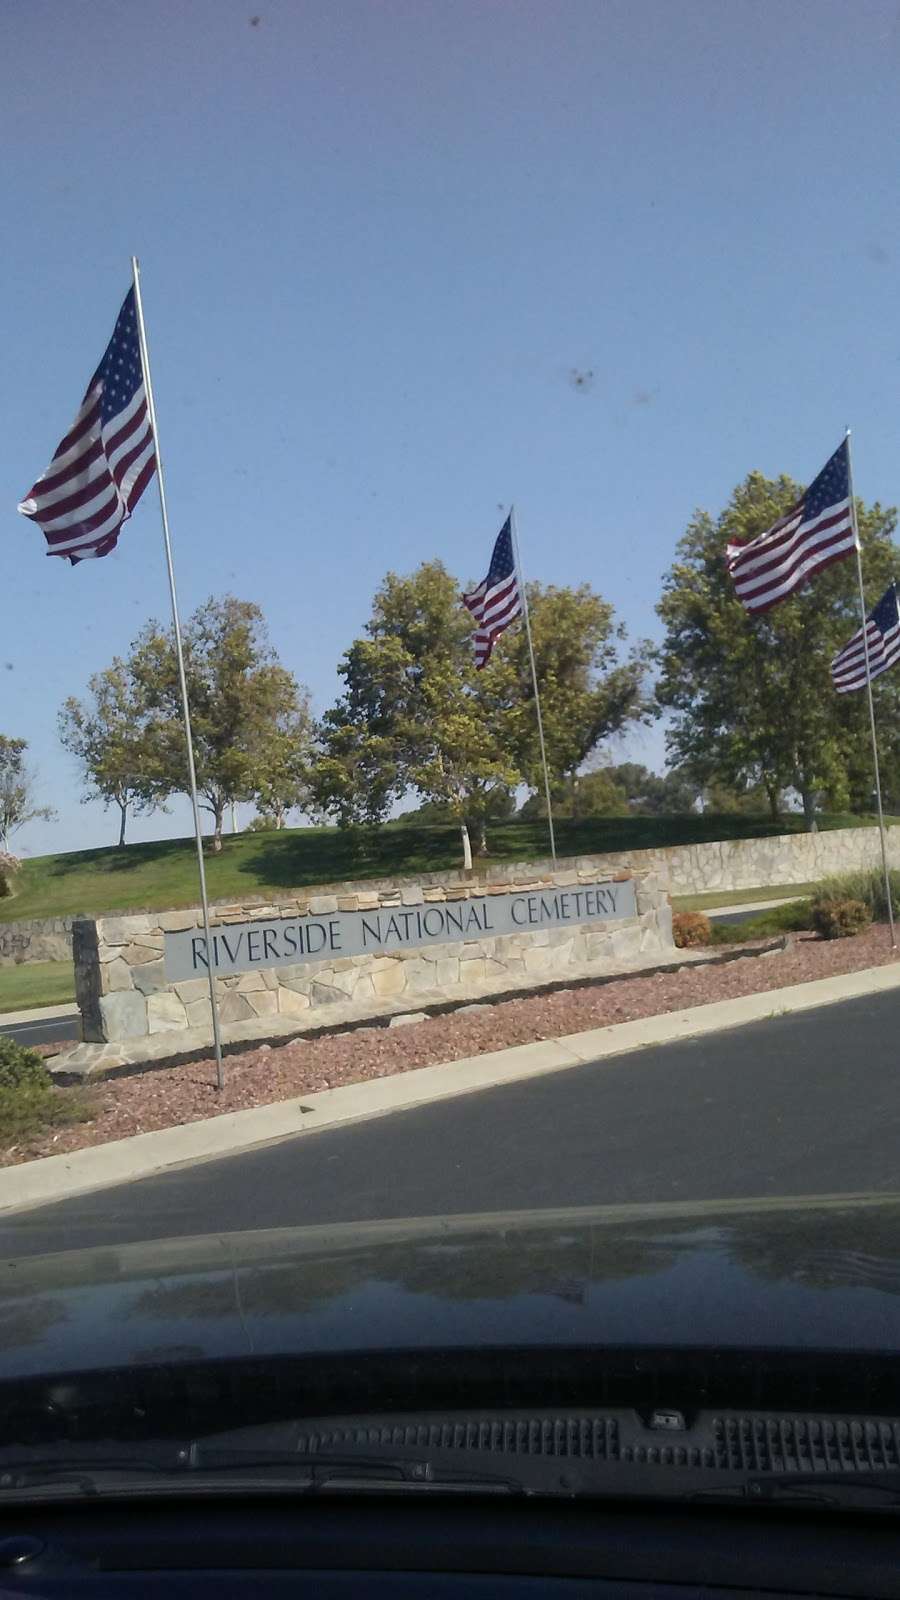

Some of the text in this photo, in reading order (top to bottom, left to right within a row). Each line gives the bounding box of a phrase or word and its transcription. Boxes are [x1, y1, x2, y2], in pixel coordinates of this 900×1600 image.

[191, 888, 619, 969] RIVERSIDE NATIONAL CEMETERY
